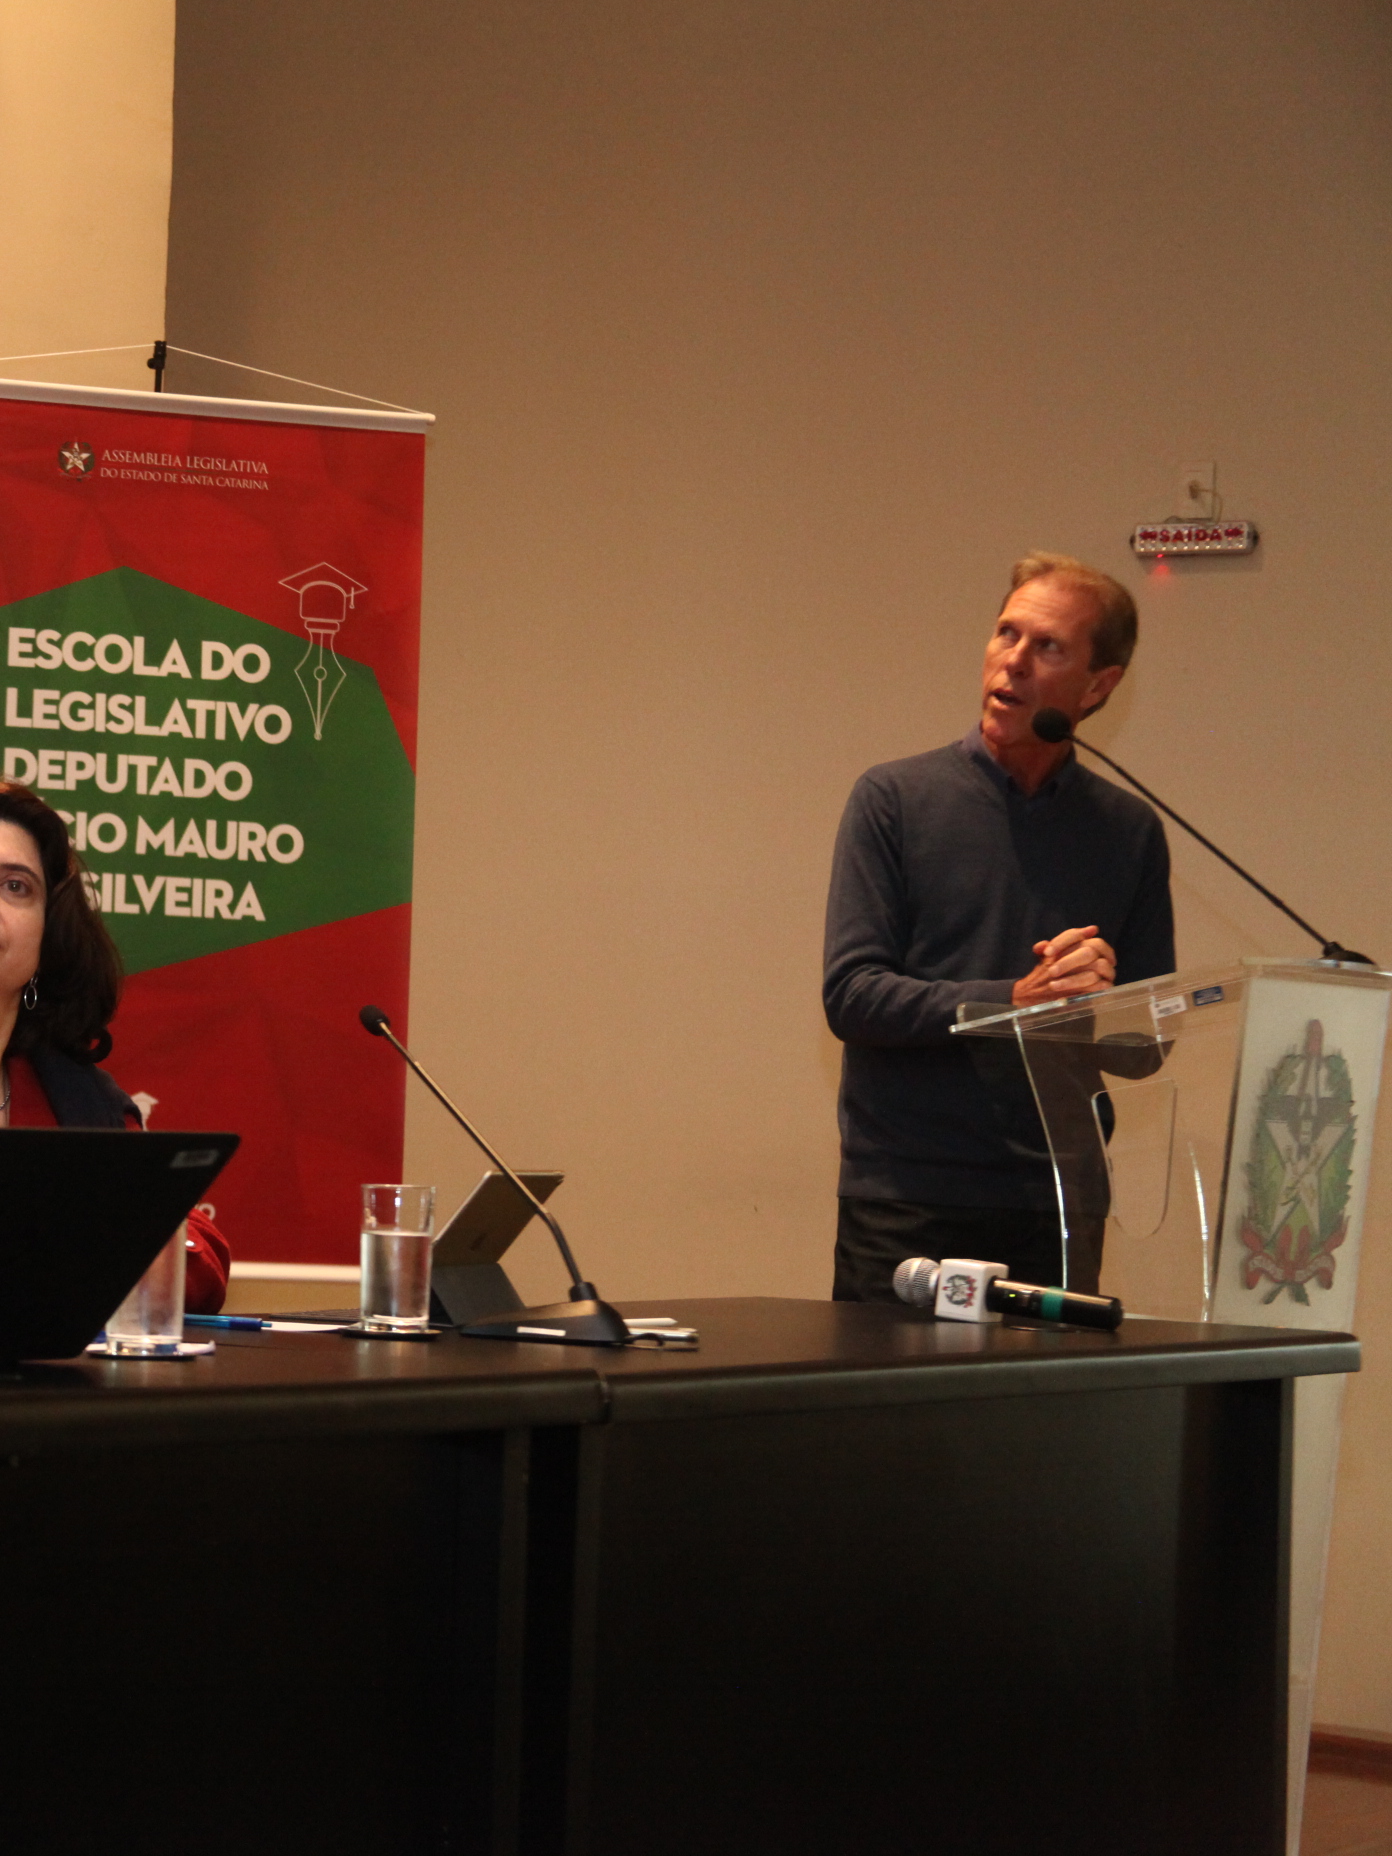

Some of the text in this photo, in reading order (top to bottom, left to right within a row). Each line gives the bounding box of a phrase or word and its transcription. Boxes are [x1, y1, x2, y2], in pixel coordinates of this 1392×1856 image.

[100, 467, 269, 491] DO ESTADO DE SANTA CATARINA
[102, 449, 269, 475] ASSEMBLEIA LEGISLATIVA
[7, 626, 271, 684] ESCOLA DO
[5, 687, 293, 745] LEGISLATIVO
[3, 747, 253, 801] DEPUTADO
[135, 815, 305, 864] MAURO
[80, 871, 266, 922] SILVEIRA
